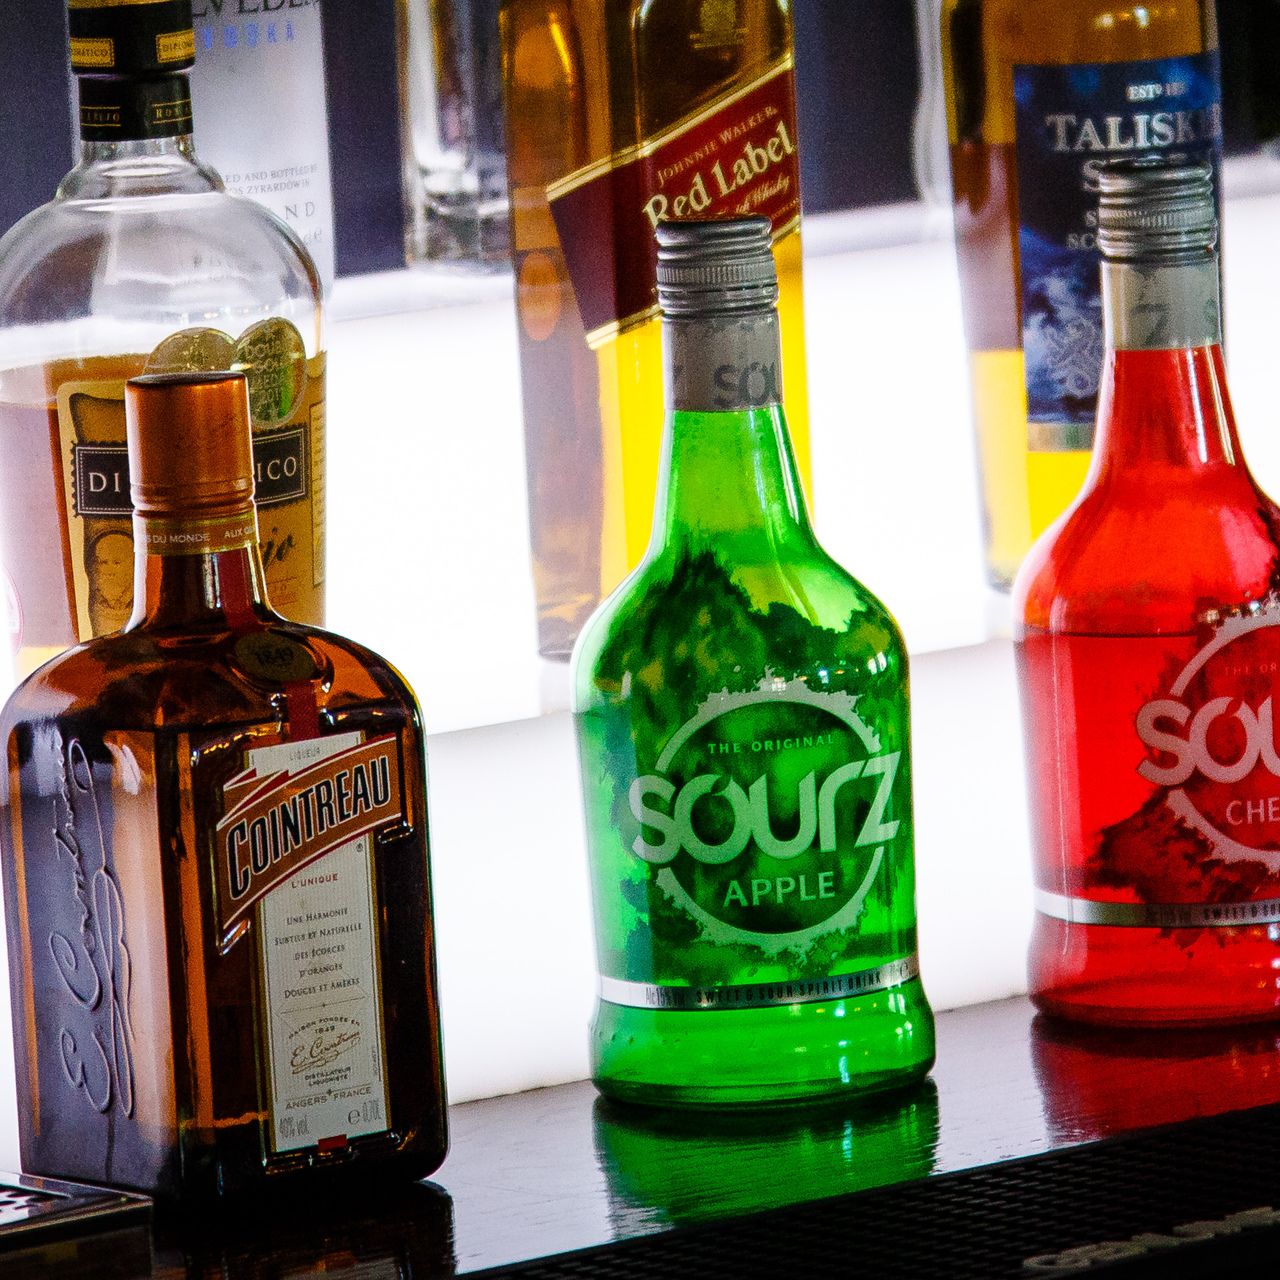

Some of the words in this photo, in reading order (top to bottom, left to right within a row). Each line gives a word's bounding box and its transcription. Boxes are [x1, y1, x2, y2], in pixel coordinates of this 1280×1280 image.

[642, 172, 713, 229] Red
[711, 120, 797, 197] Label
[170, 532, 211, 544] MONDE
[1223, 662, 1251, 677] THE
[289, 747, 321, 762] LIQUEUR
[707, 742, 742, 756] THE
[751, 733, 836, 753] ORIGINAL
[226, 755, 392, 901] COINTREAU
[291, 873, 339, 889] L'UNIQUE
[723, 871, 837, 908] APPLE
[696, 988, 740, 1004] SWEET
[758, 985, 794, 1001] SOUR
[798, 979, 843, 997] SPIRIT
[848, 971, 882, 991] DRINK
[285, 1095, 328, 1110] ANGERS
[333, 1087, 372, 1101] FRANCE
